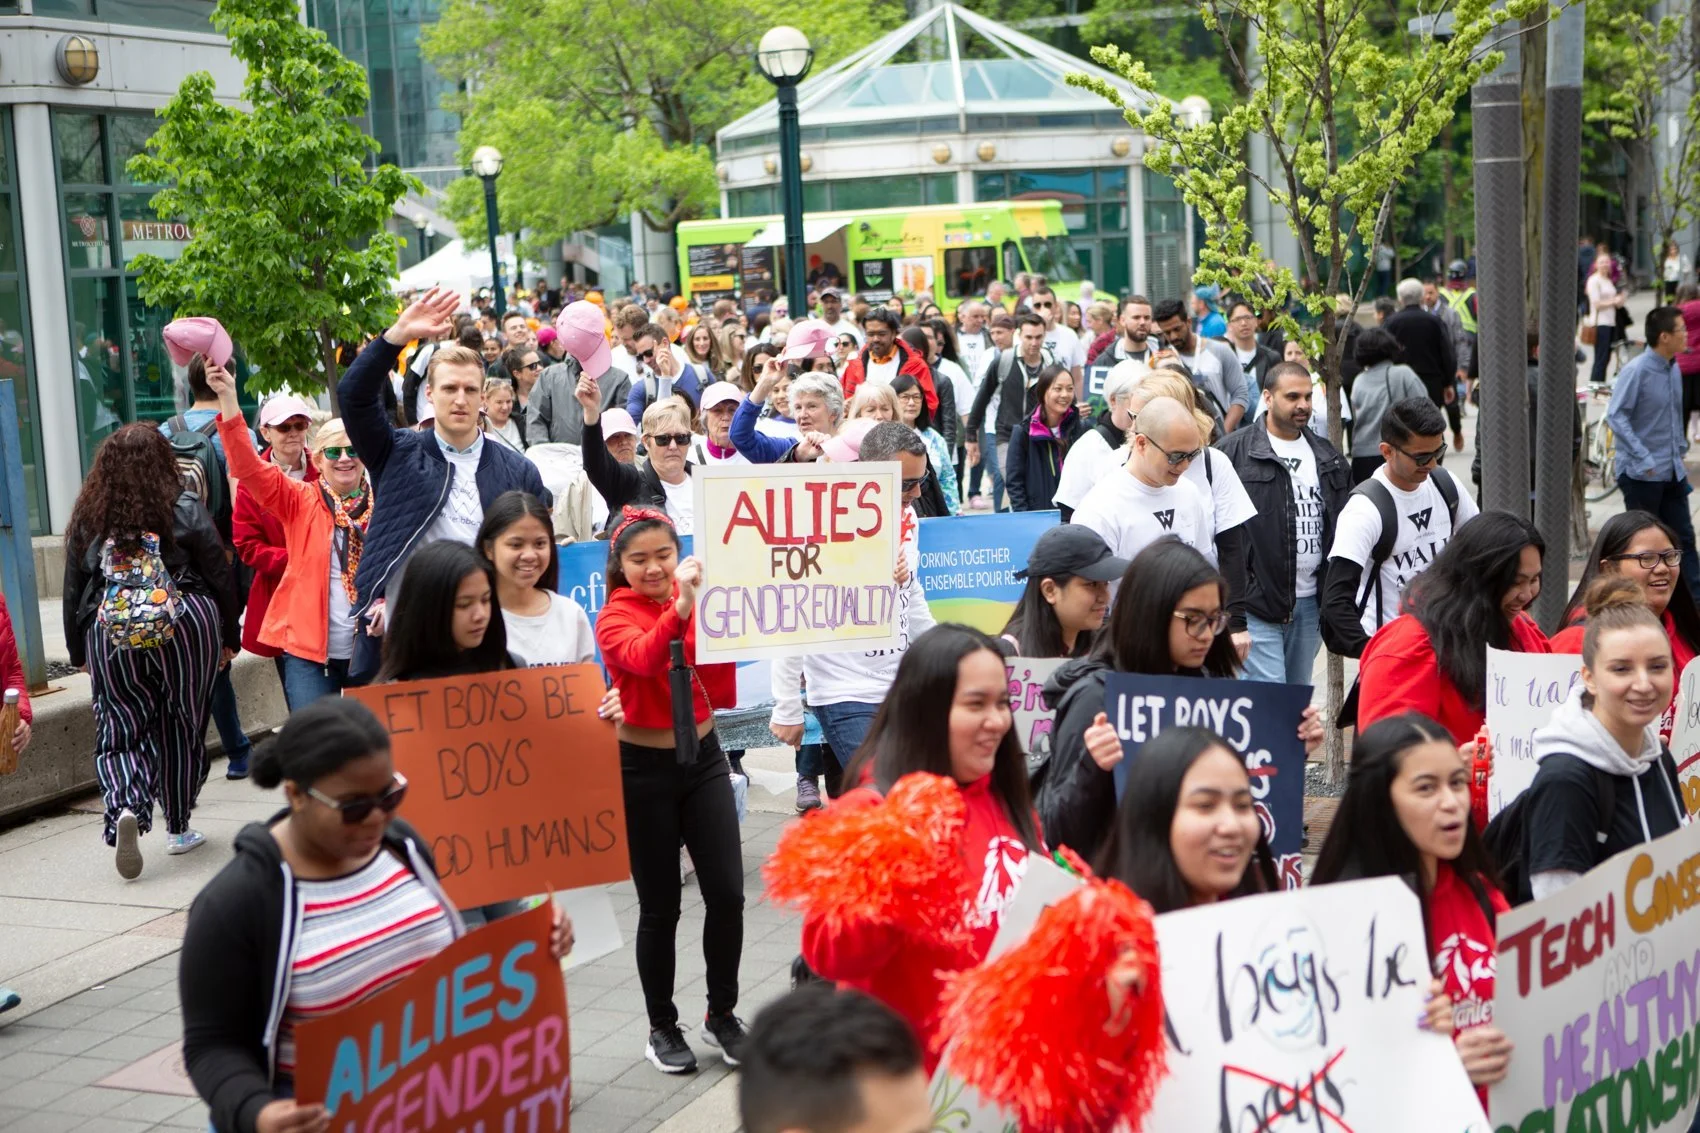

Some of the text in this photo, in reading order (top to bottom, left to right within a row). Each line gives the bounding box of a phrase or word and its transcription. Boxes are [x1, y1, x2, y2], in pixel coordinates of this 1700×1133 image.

[722, 481, 883, 546] ALLIES
[771, 542, 823, 581] FOR
[917, 547, 1011, 570] ORKING TOGETHER
[925, 572, 975, 591] ENSEMBLE
[976, 571, 1001, 588] POUR
[1392, 537, 1448, 572] WAL
[700, 583, 811, 639] GENDER
[812, 583, 898, 631] EQUALITY
[443, 679, 528, 730] BOYS
[542, 673, 585, 720] BE
[1117, 693, 1166, 743] LET
[437, 738, 533, 801] BOYS
[1510, 727, 1538, 761] mil
[486, 809, 617, 870] HUMANS
[1497, 891, 1615, 999] TEACH
[1602, 937, 1655, 1001] AND
[323, 939, 538, 1117] ALLIES
[1543, 947, 1700, 1109] HEALTHY
[364, 1015, 564, 1133] GENDER
